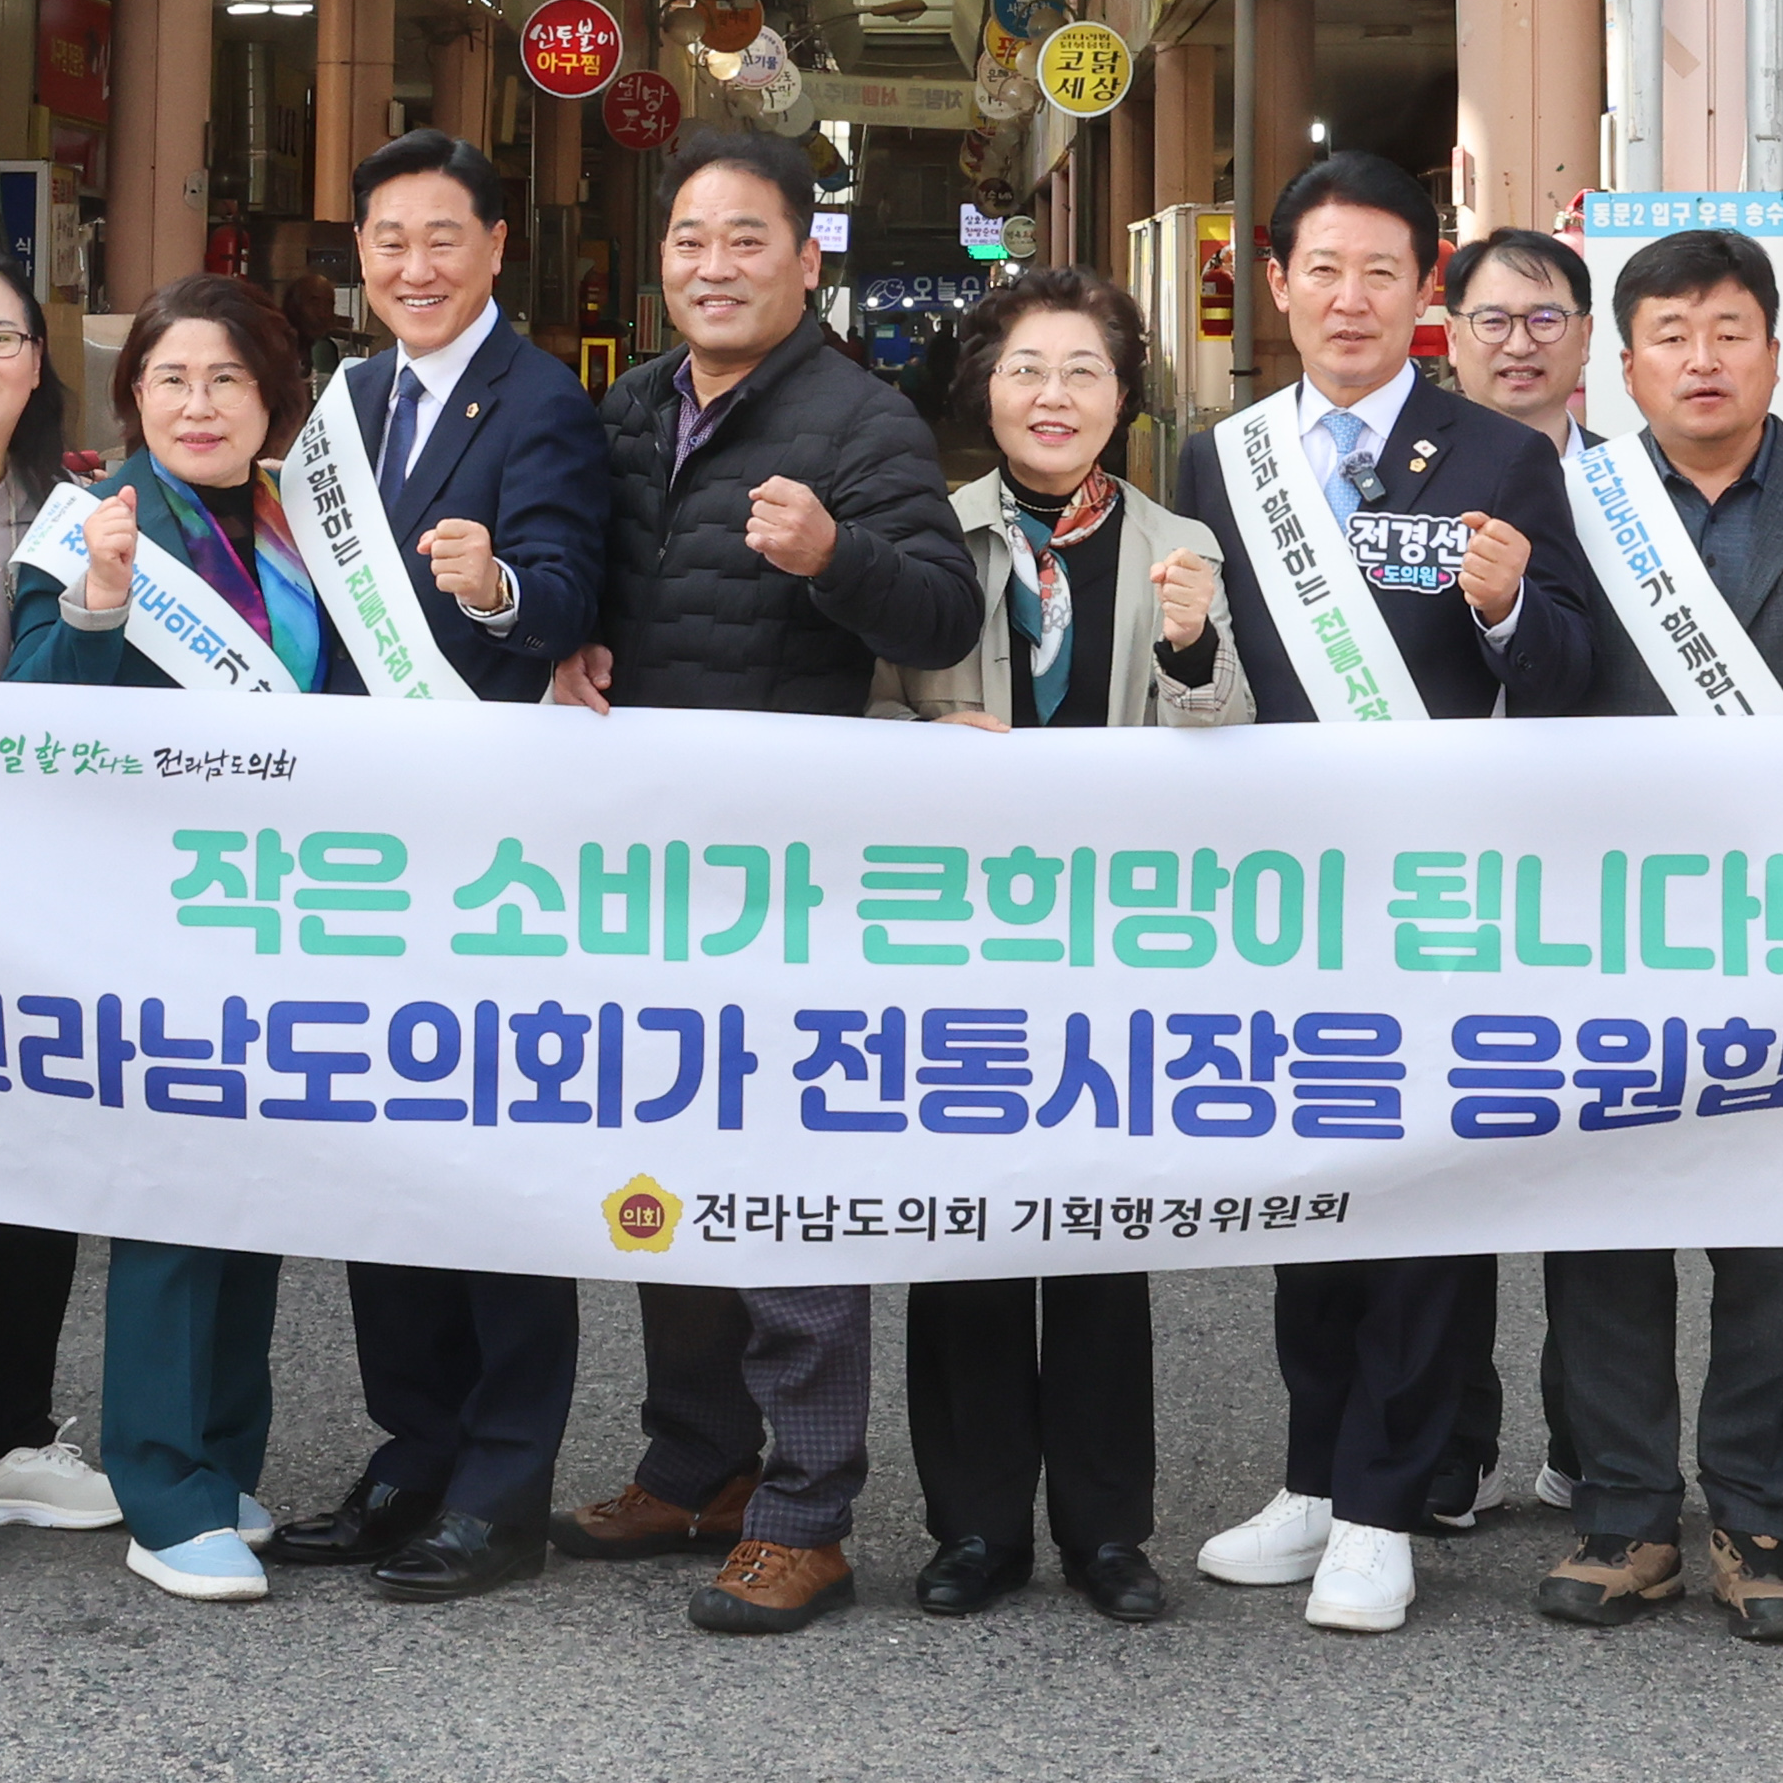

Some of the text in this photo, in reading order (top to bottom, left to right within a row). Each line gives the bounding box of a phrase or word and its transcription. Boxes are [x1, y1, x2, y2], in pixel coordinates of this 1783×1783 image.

[529, 17, 615, 52] 신토불이
[537, 51, 601, 76] 아구찜
[616, 76, 670, 112] 희망
[1053, 77, 1121, 101] 세상
[1592, 202, 1644, 227] 동문2
[1651, 202, 1691, 227] 입구
[1697, 202, 1738, 227] 우측
[914, 276, 981, 301] 오늘수
[1242, 414, 1279, 492] 도민과
[1260, 487, 1332, 607] 함께하는
[1351, 517, 1473, 564] 전경선
[1575, 445, 1678, 608] 전라남도의회가
[305, 467, 363, 566] 함께하는
[344, 563, 414, 682] 전통시장
[1382, 564, 1439, 588] 도의원
[154, 747, 297, 782] 전라남도의회
[169, 827, 410, 957] 작은
[450, 835, 823, 965] 소비가
[854, 841, 1346, 971] 큰희망이
[792, 1004, 1407, 1141] 전통시장을
[692, 1189, 1353, 1245] 전라남도의회 기획행정위원회
